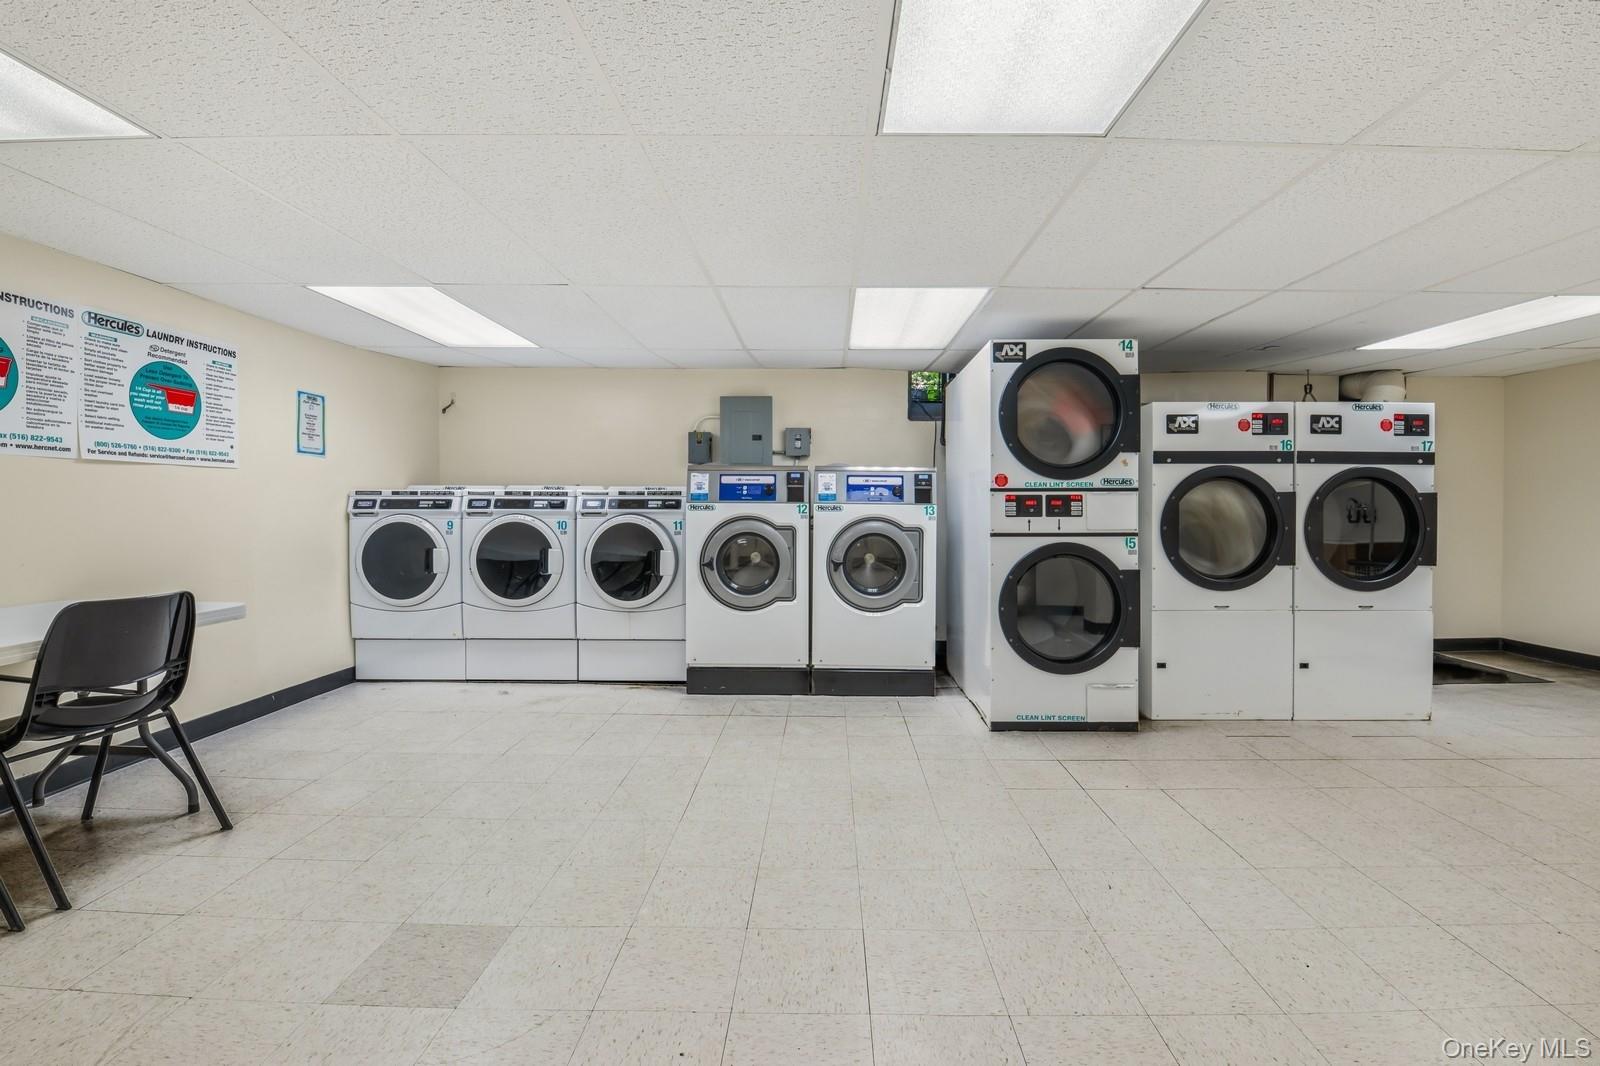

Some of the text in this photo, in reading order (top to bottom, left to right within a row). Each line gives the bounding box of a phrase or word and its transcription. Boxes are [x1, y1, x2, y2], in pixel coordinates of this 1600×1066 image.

[88, 312, 140, 334] Hercules
[146, 329, 184, 345] LAUNDRY
[186, 340, 236, 358] INSTRUCTIONS
[1120, 340, 1133, 352] 14
[160, 347, 186, 358] Detergent
[148, 352, 188, 365] Recommended
[10, 433, 28, 442] (516)
[30, 435, 62, 444] 822-9543
[15, 443, 72, 452] www.hercnet.com
[1280, 440, 1292, 451] 16
[1421, 440, 1434, 452] 17
[796, 504, 808, 514] 12
[924, 506, 935, 516] 13
[447, 520, 453, 530] 9
[556, 520, 567, 530] 10
[673, 521, 683, 530] 11
